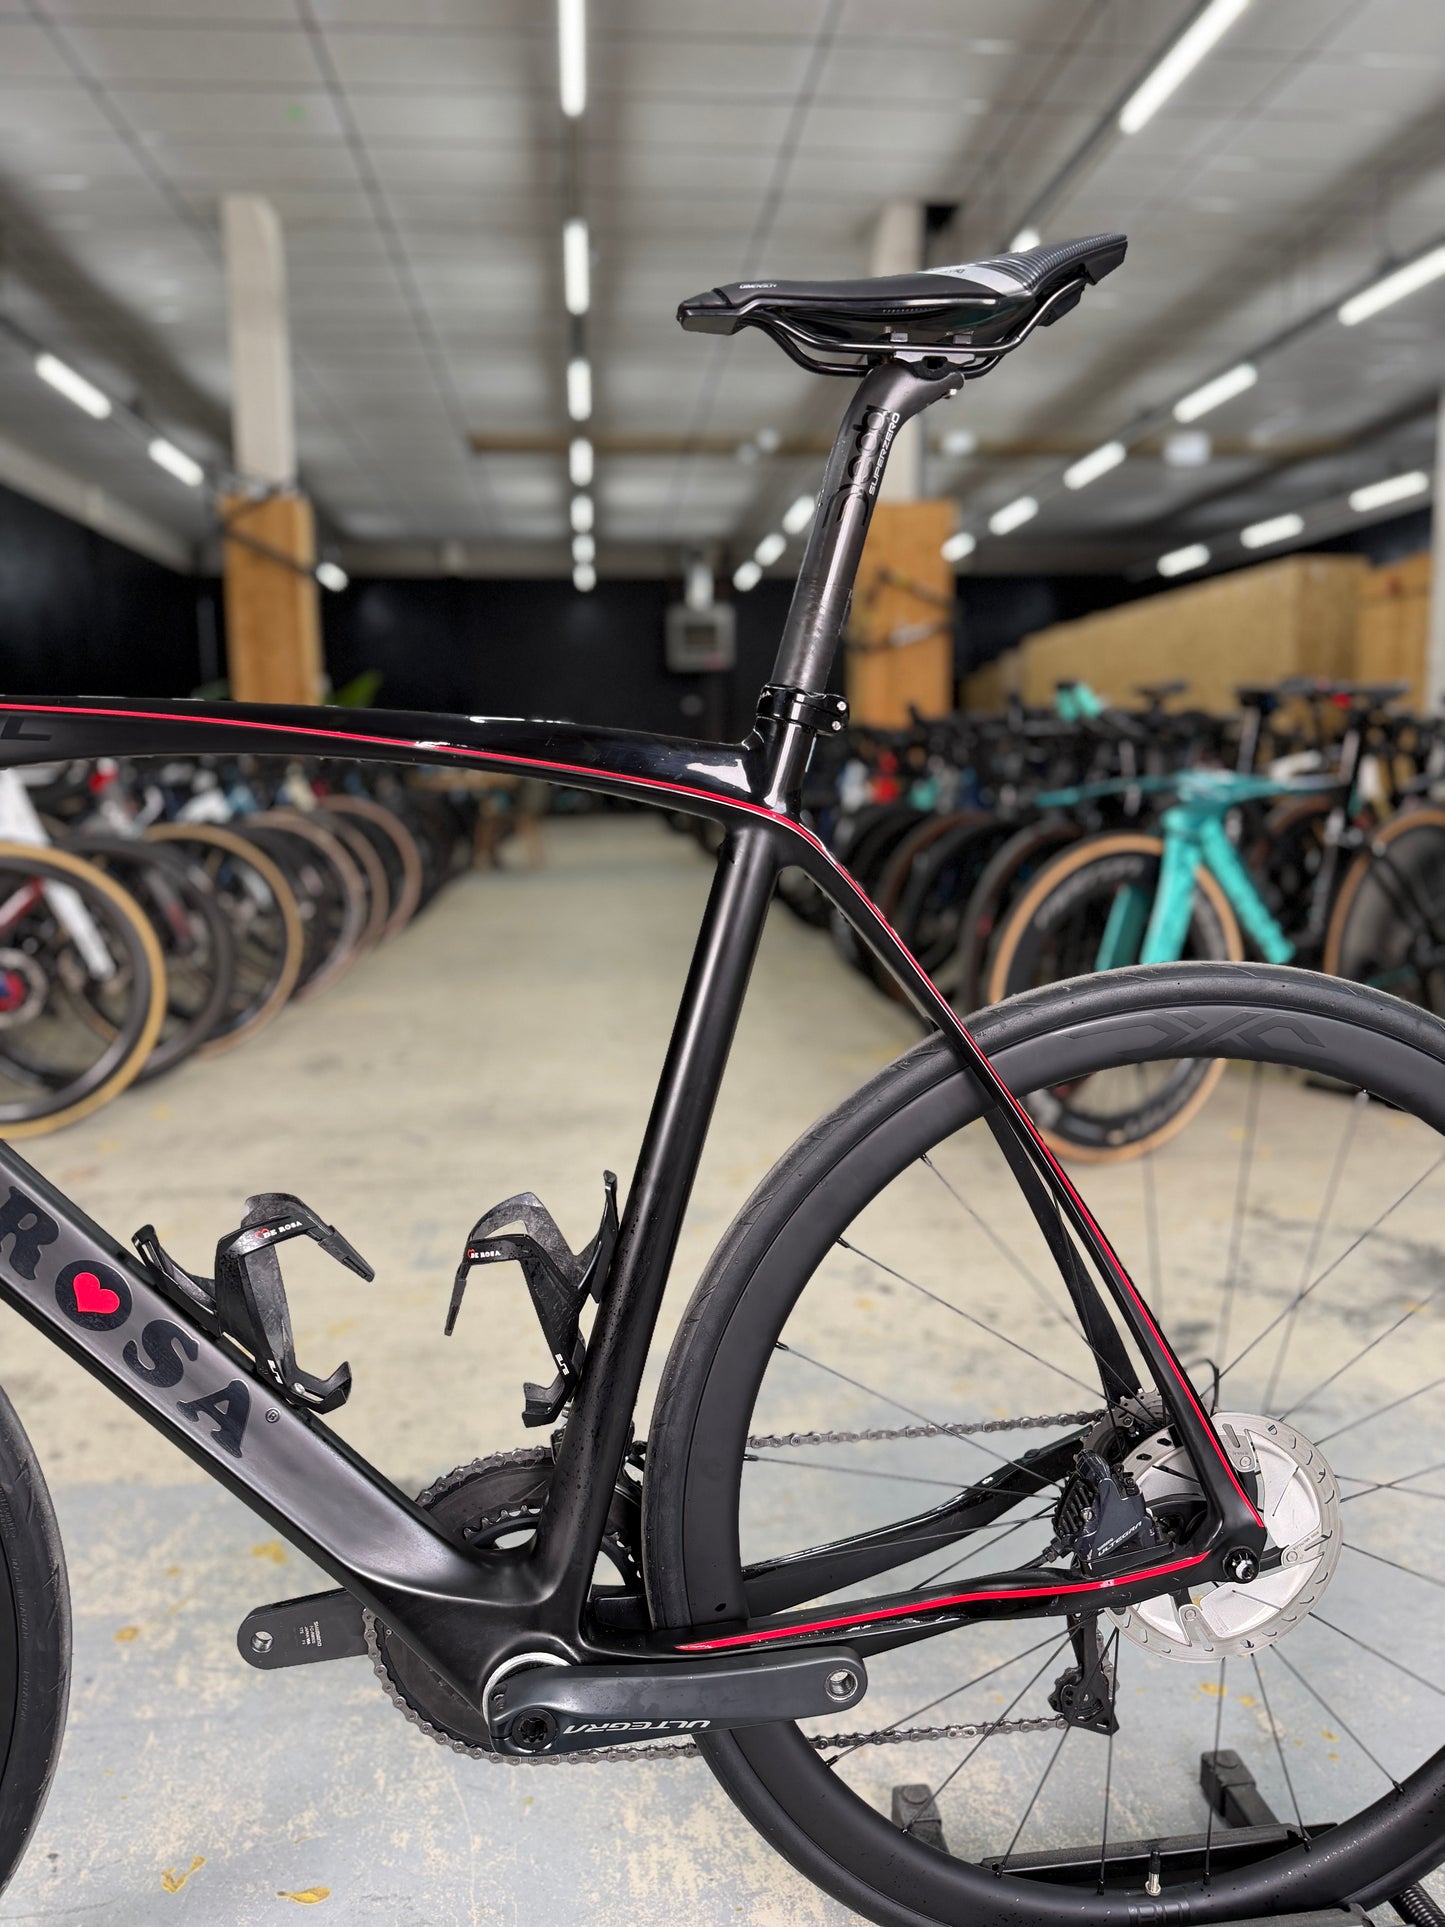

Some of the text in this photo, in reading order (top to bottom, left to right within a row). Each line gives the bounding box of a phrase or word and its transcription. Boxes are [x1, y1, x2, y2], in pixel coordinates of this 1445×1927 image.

[868, 412, 900, 496] SUPERZERO
[278, 1220, 303, 1234] ROSA
[562, 1719, 711, 1736] ULTEGRA
